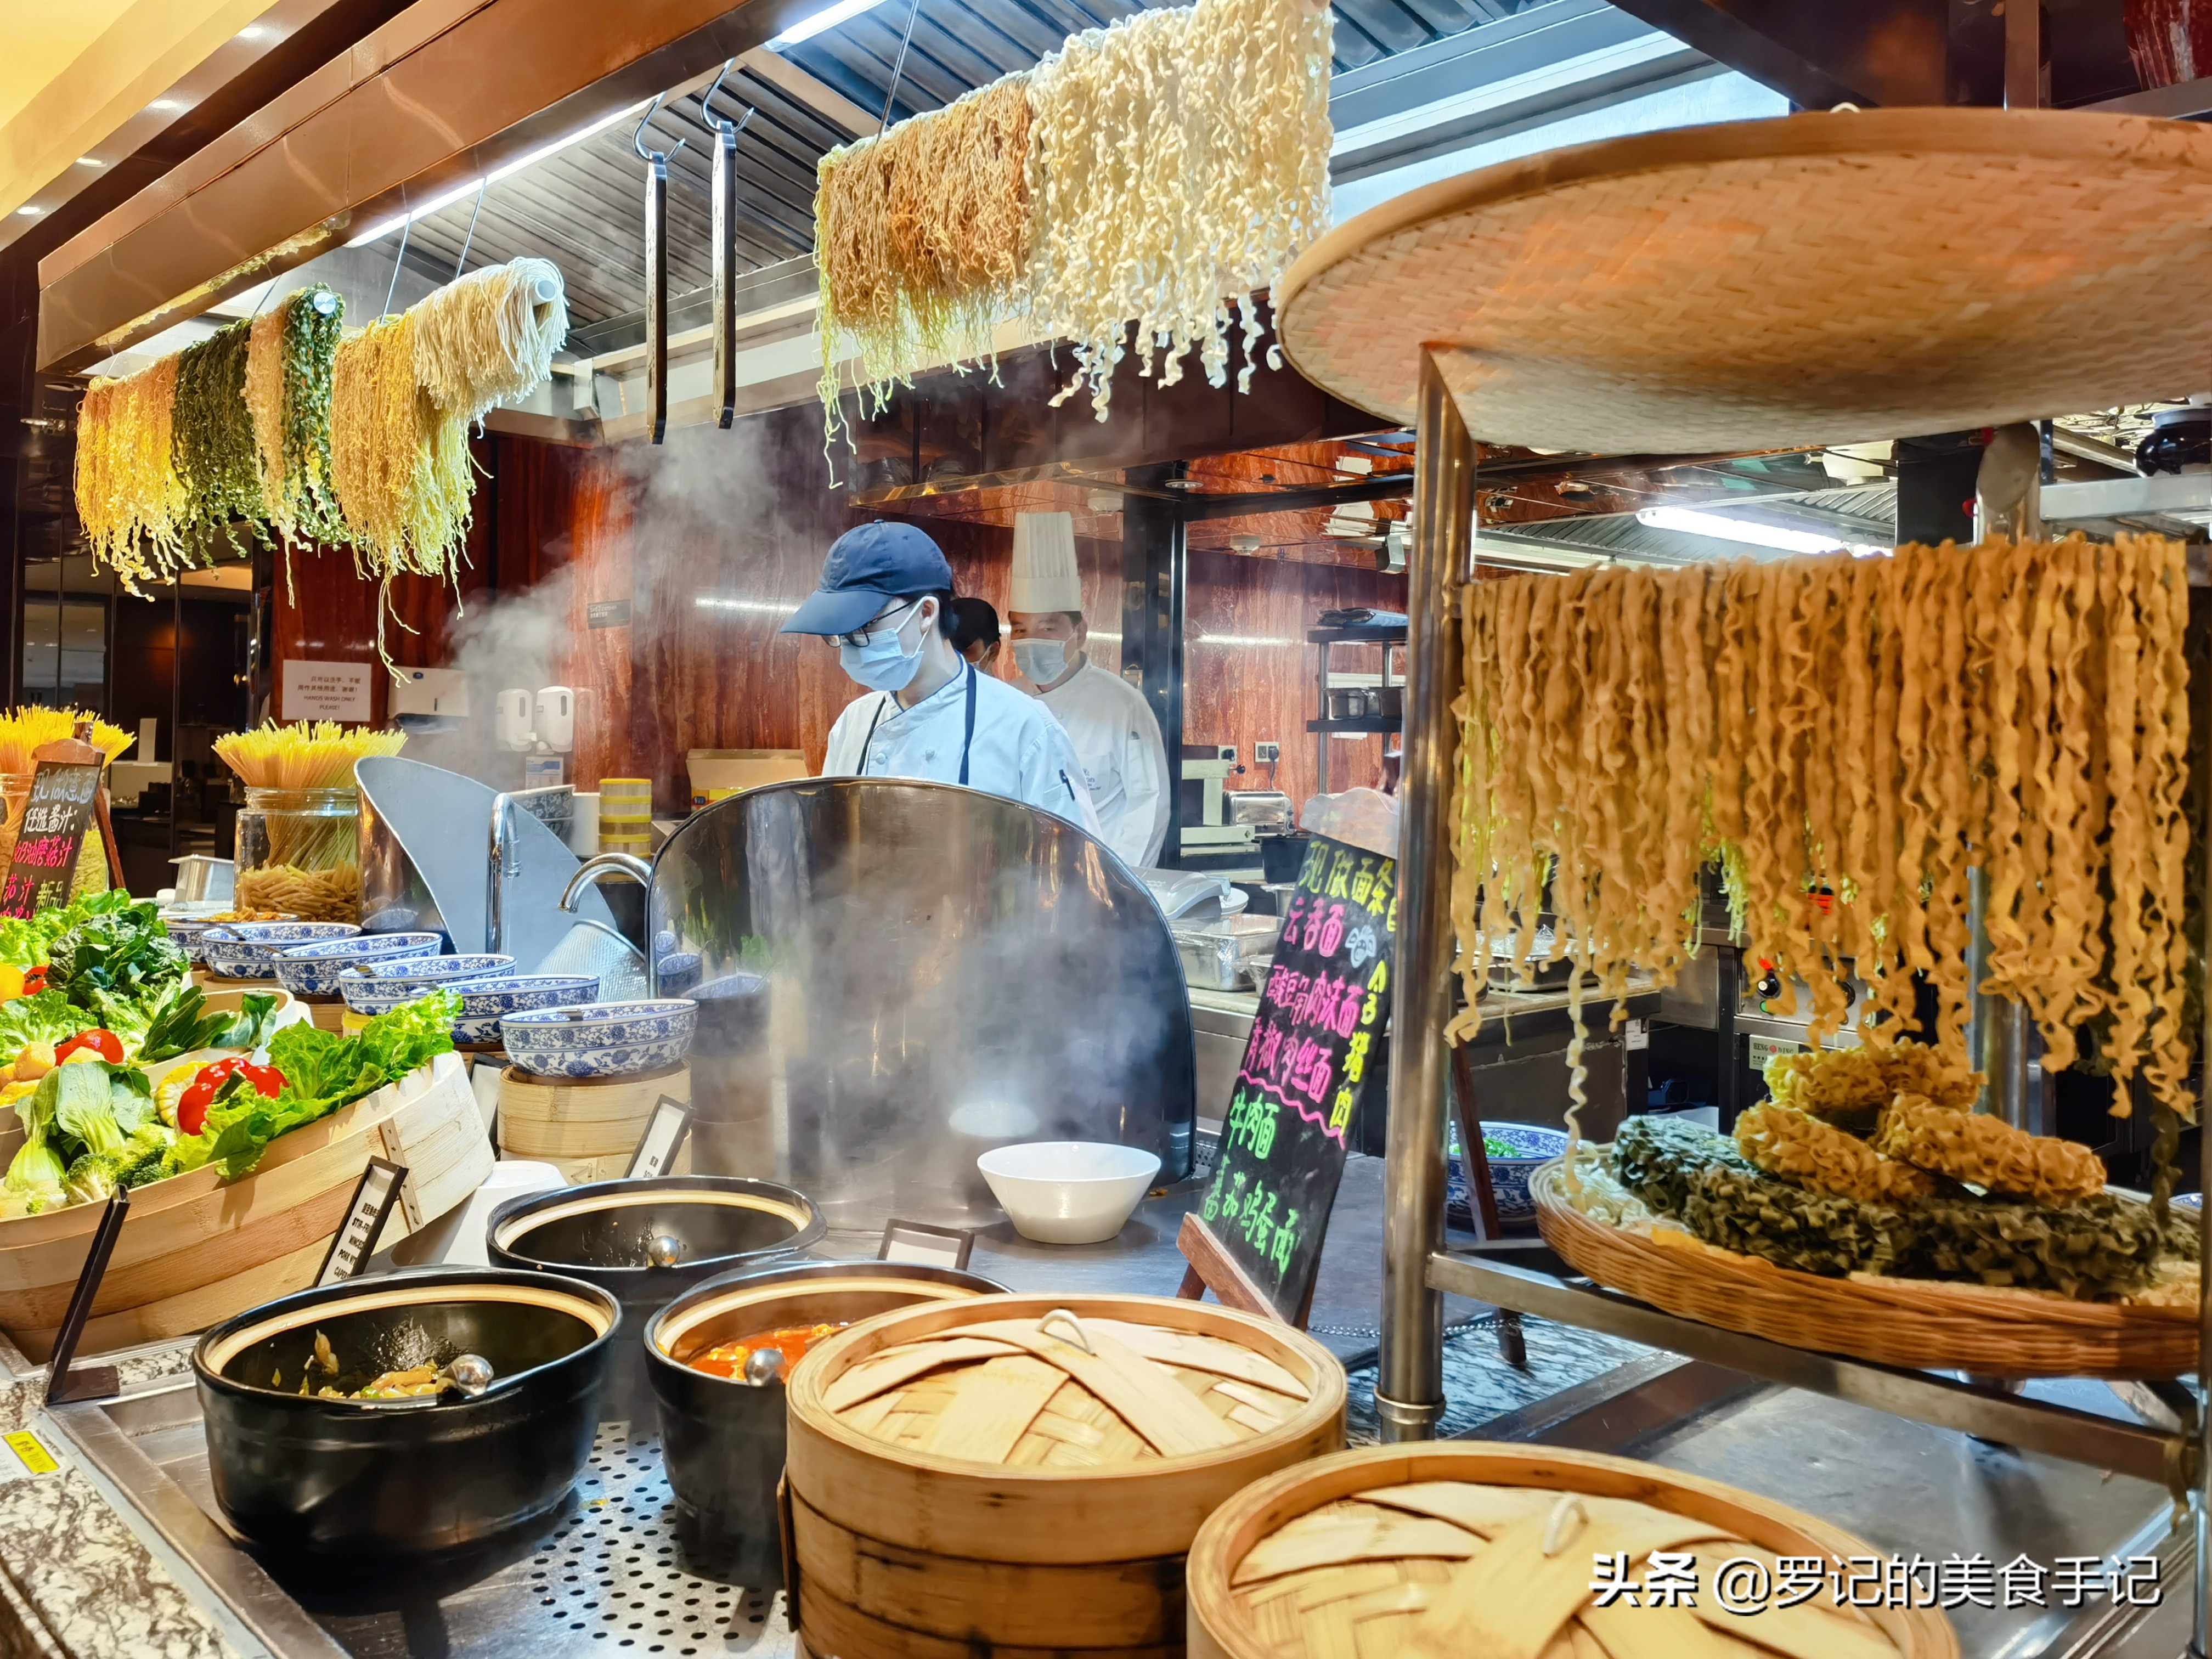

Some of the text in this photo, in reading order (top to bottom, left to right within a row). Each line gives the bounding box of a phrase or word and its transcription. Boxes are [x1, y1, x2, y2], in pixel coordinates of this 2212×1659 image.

[36, 879, 64, 912] 新品
[1283, 896, 1346, 958] 云吞面
[1243, 1017, 1333, 1103] 青椒肉丝面
[1227, 1085, 1280, 1160] 牛肉面
[337, 1249, 350, 1261] PORK
